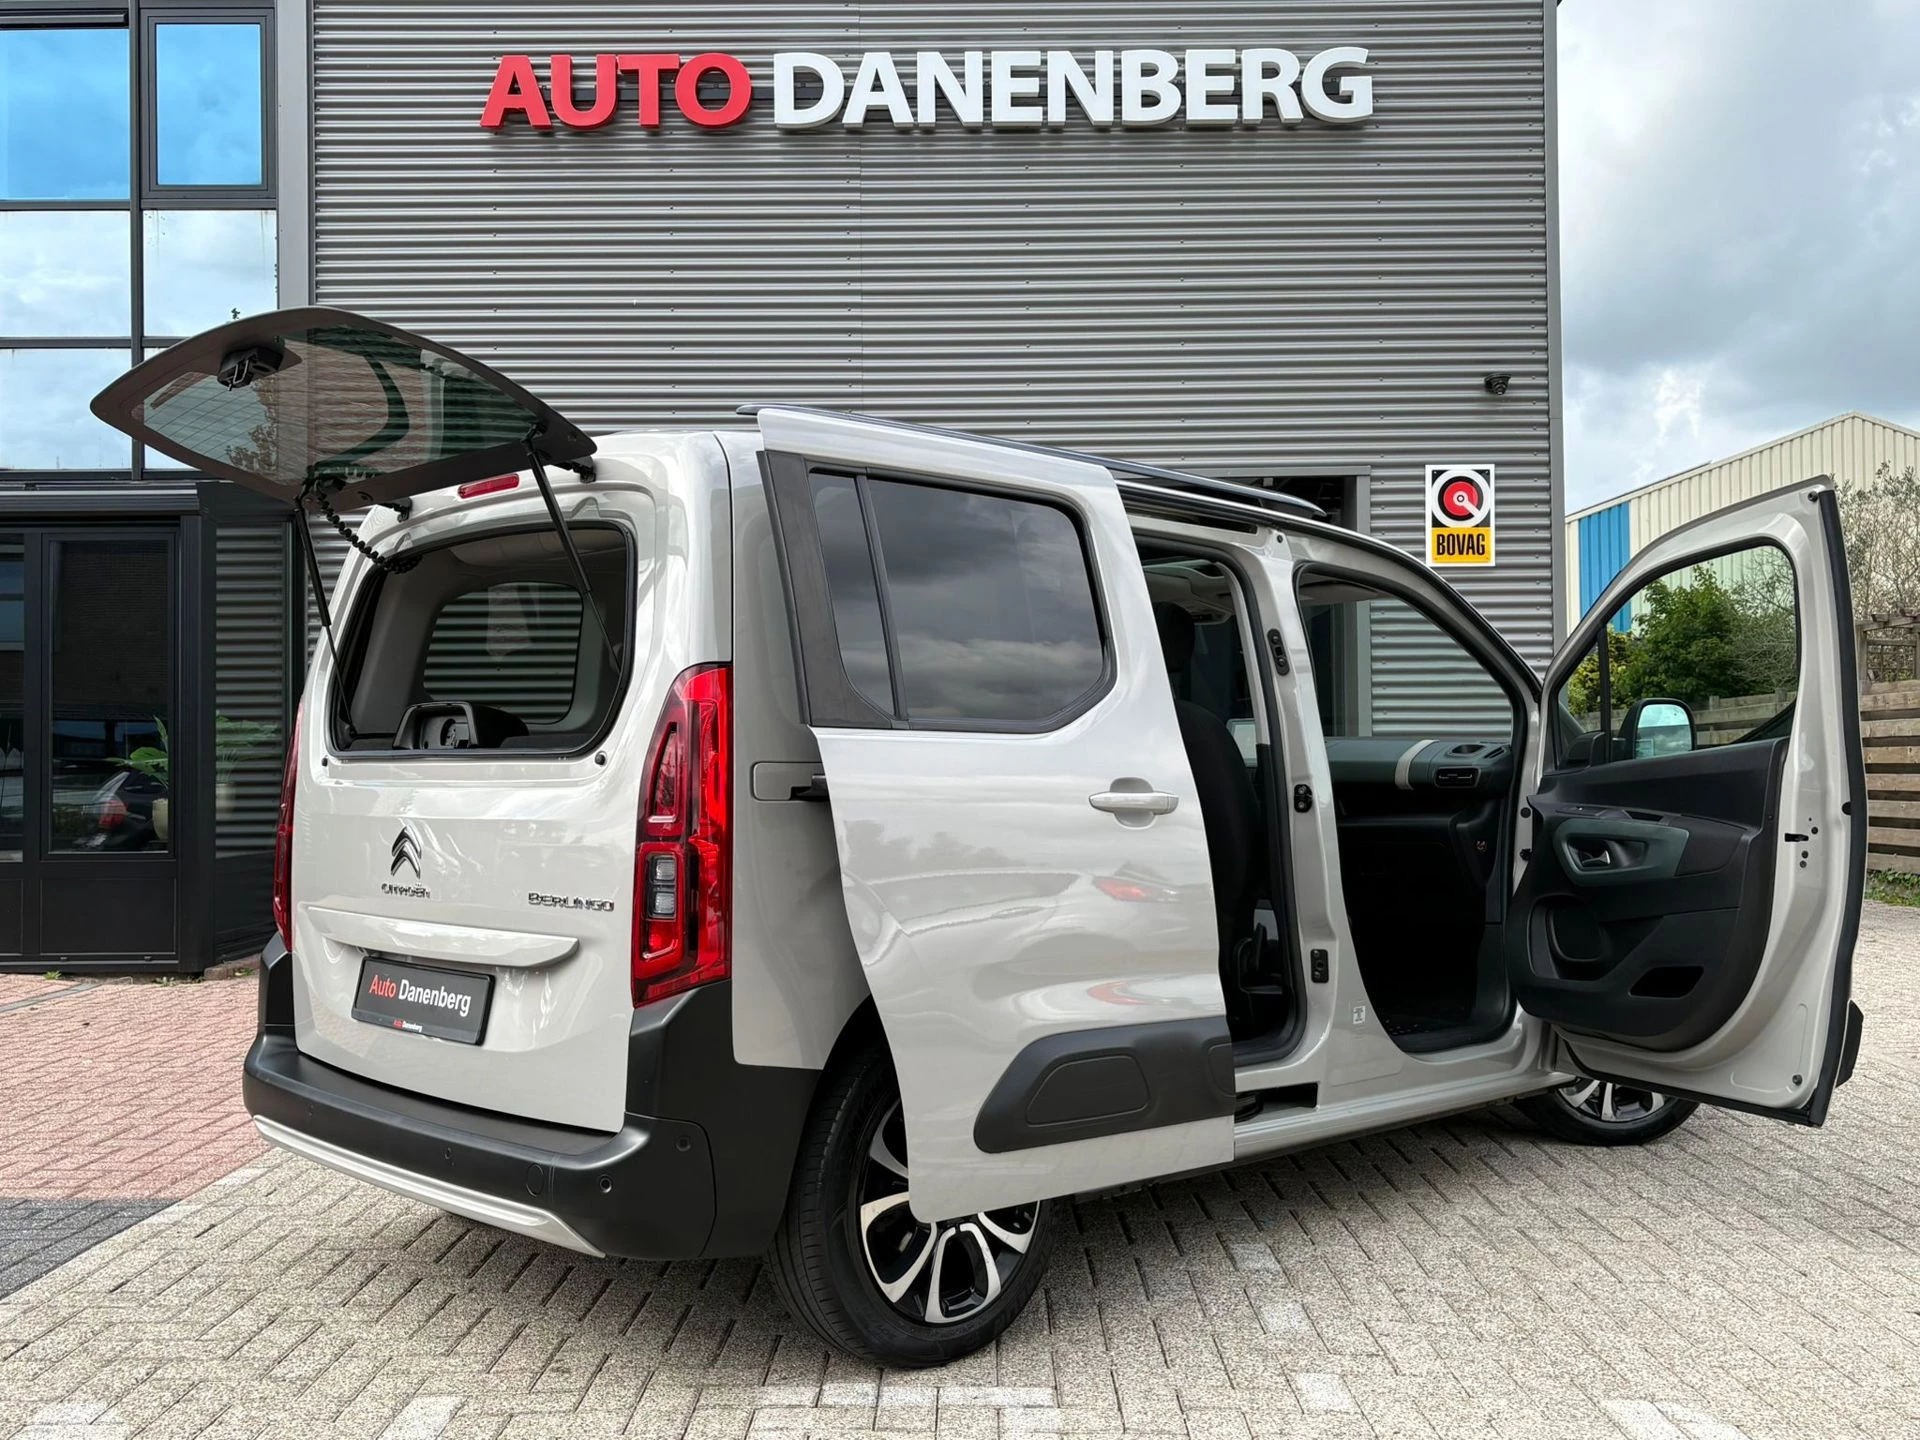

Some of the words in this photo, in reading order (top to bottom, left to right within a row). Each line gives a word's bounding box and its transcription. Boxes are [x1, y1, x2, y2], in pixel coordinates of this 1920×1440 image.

[480, 52, 752, 129] AUTO
[773, 46, 1374, 128] DANENBERG
[1436, 533, 1486, 556] BOVAG
[528, 892, 615, 912] BERLINGO
[369, 974, 397, 998] Auto
[398, 978, 472, 1017] Danenberg
